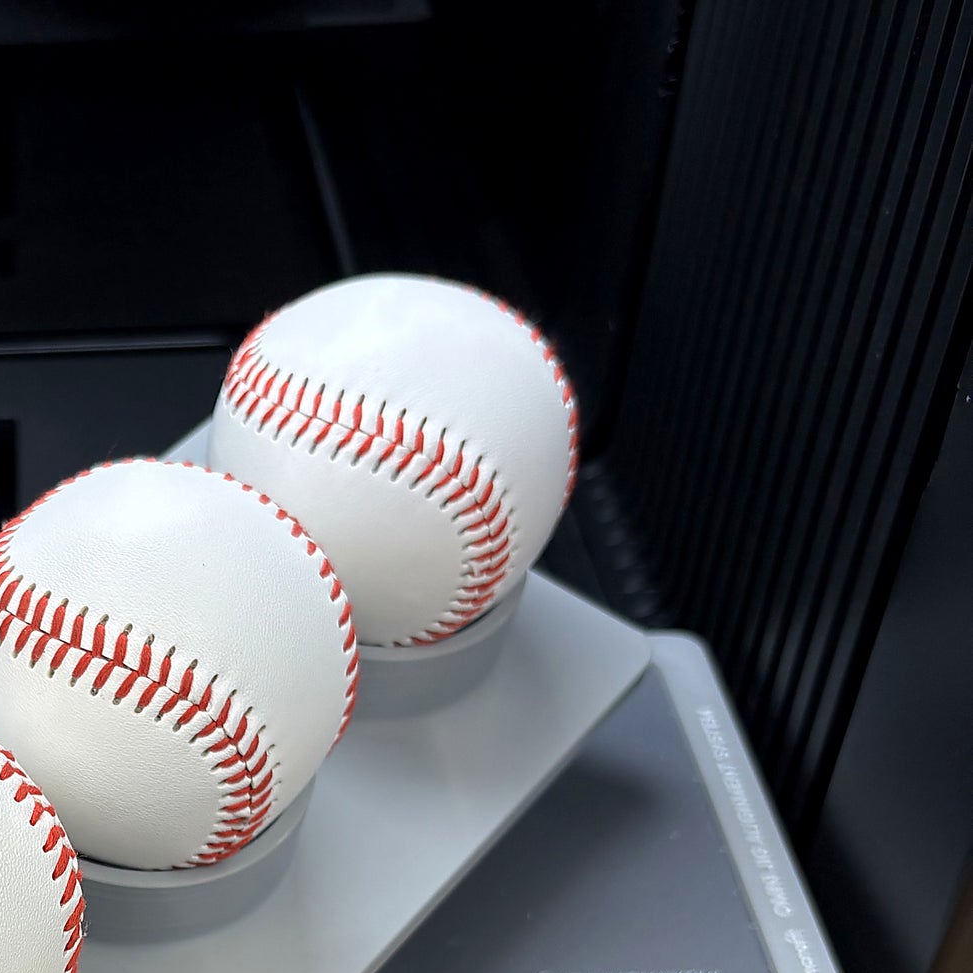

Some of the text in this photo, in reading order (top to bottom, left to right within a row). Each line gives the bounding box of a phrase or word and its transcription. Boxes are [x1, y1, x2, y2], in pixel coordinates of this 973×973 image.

[696, 707, 729, 762] SYSTEM
[720, 764, 764, 843] ALIGNMENT
[751, 844, 775, 871] JIG
[762, 874, 792, 917] OMNI
